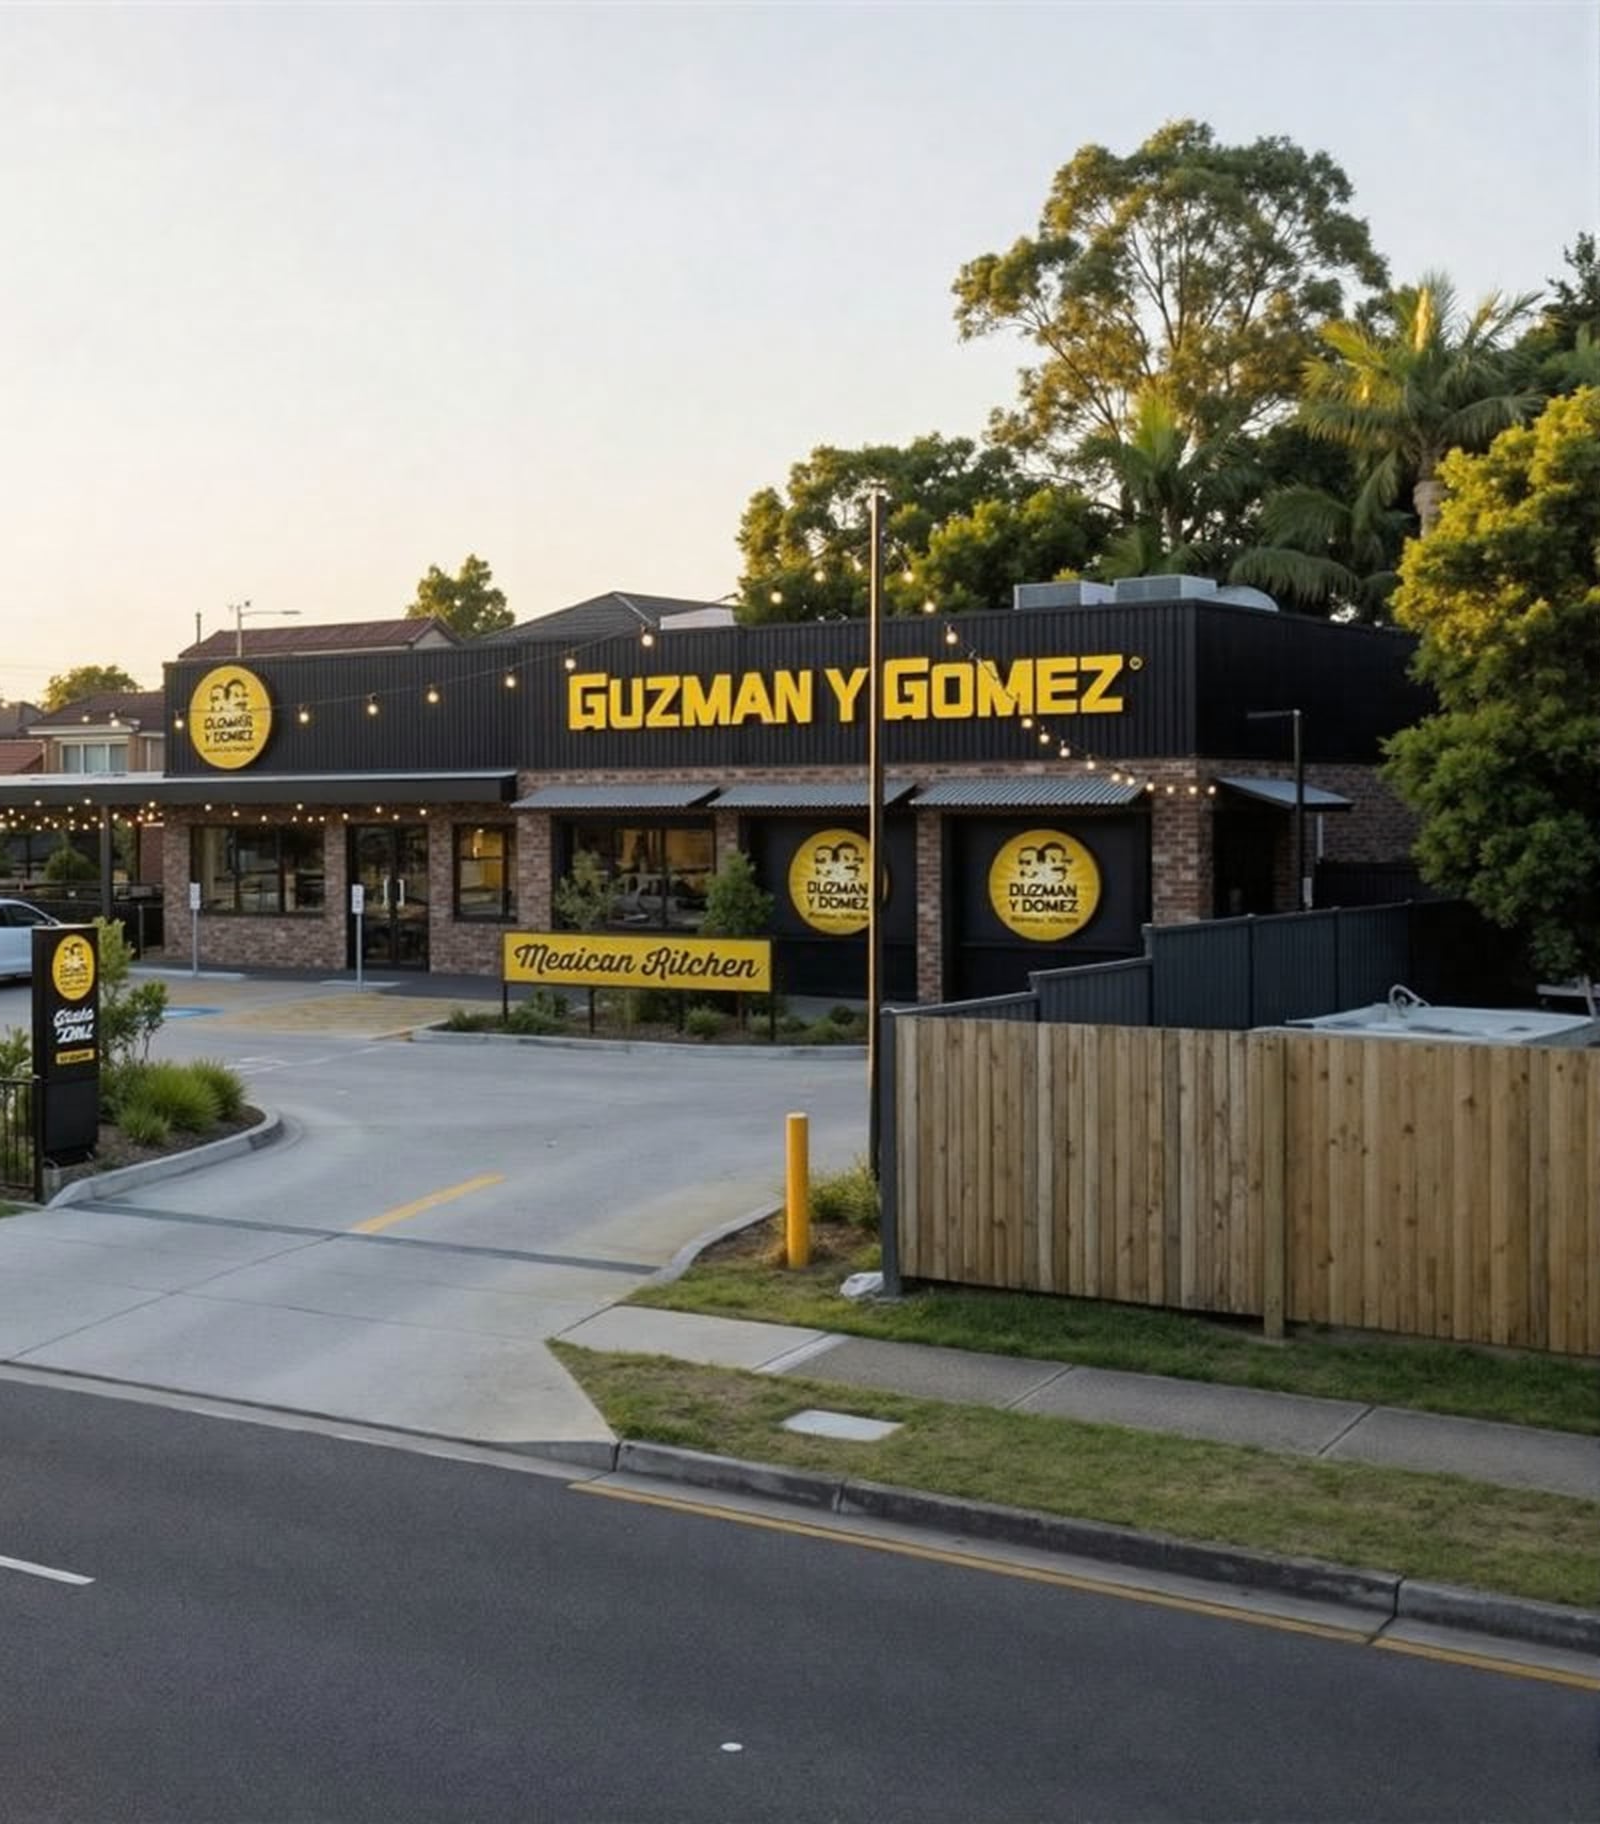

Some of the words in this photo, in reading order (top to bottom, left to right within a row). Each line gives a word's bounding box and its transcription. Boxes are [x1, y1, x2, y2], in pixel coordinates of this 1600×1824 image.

[568, 670, 813, 730] GUZMAN
[825, 667, 869, 722] Y
[883, 654, 1125, 720] GOMEZ
